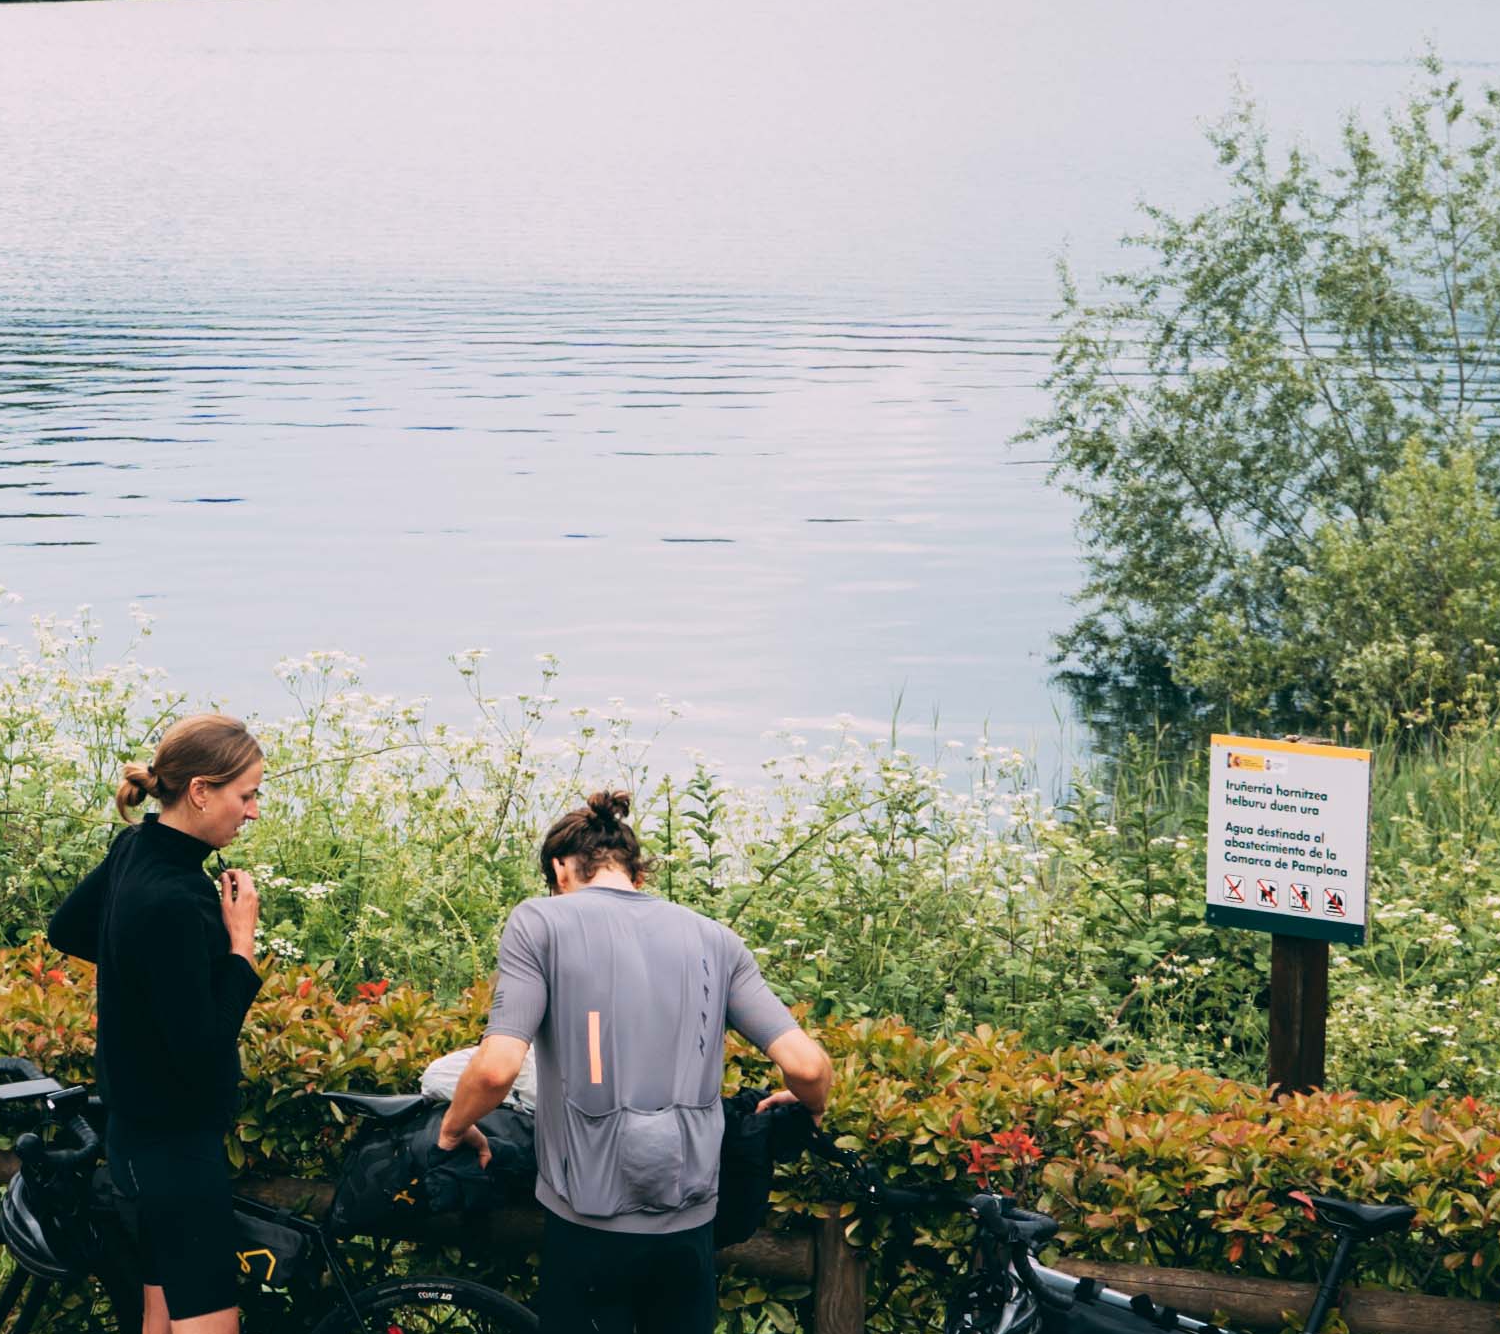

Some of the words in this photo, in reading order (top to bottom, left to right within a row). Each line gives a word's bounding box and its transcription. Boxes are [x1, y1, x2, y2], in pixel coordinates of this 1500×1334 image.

[1226, 779, 1273, 795] Iruñerria
[1276, 783, 1328, 801] hornitzea
[1225, 794, 1266, 809] helburu
[1270, 799, 1297, 815] duen
[1300, 806, 1320, 816] ura
[1225, 821, 1254, 836] Agua
[1257, 824, 1311, 842] destinada
[1314, 831, 1325, 844] al
[1224, 837, 1306, 857] abastecimiento
[1309, 847, 1323, 859] de
[1326, 848, 1337, 861] la
[1224, 851, 1272, 868] Comarca
[1274, 857, 1289, 870] de
[1291, 860, 1348, 877] Pamplona
